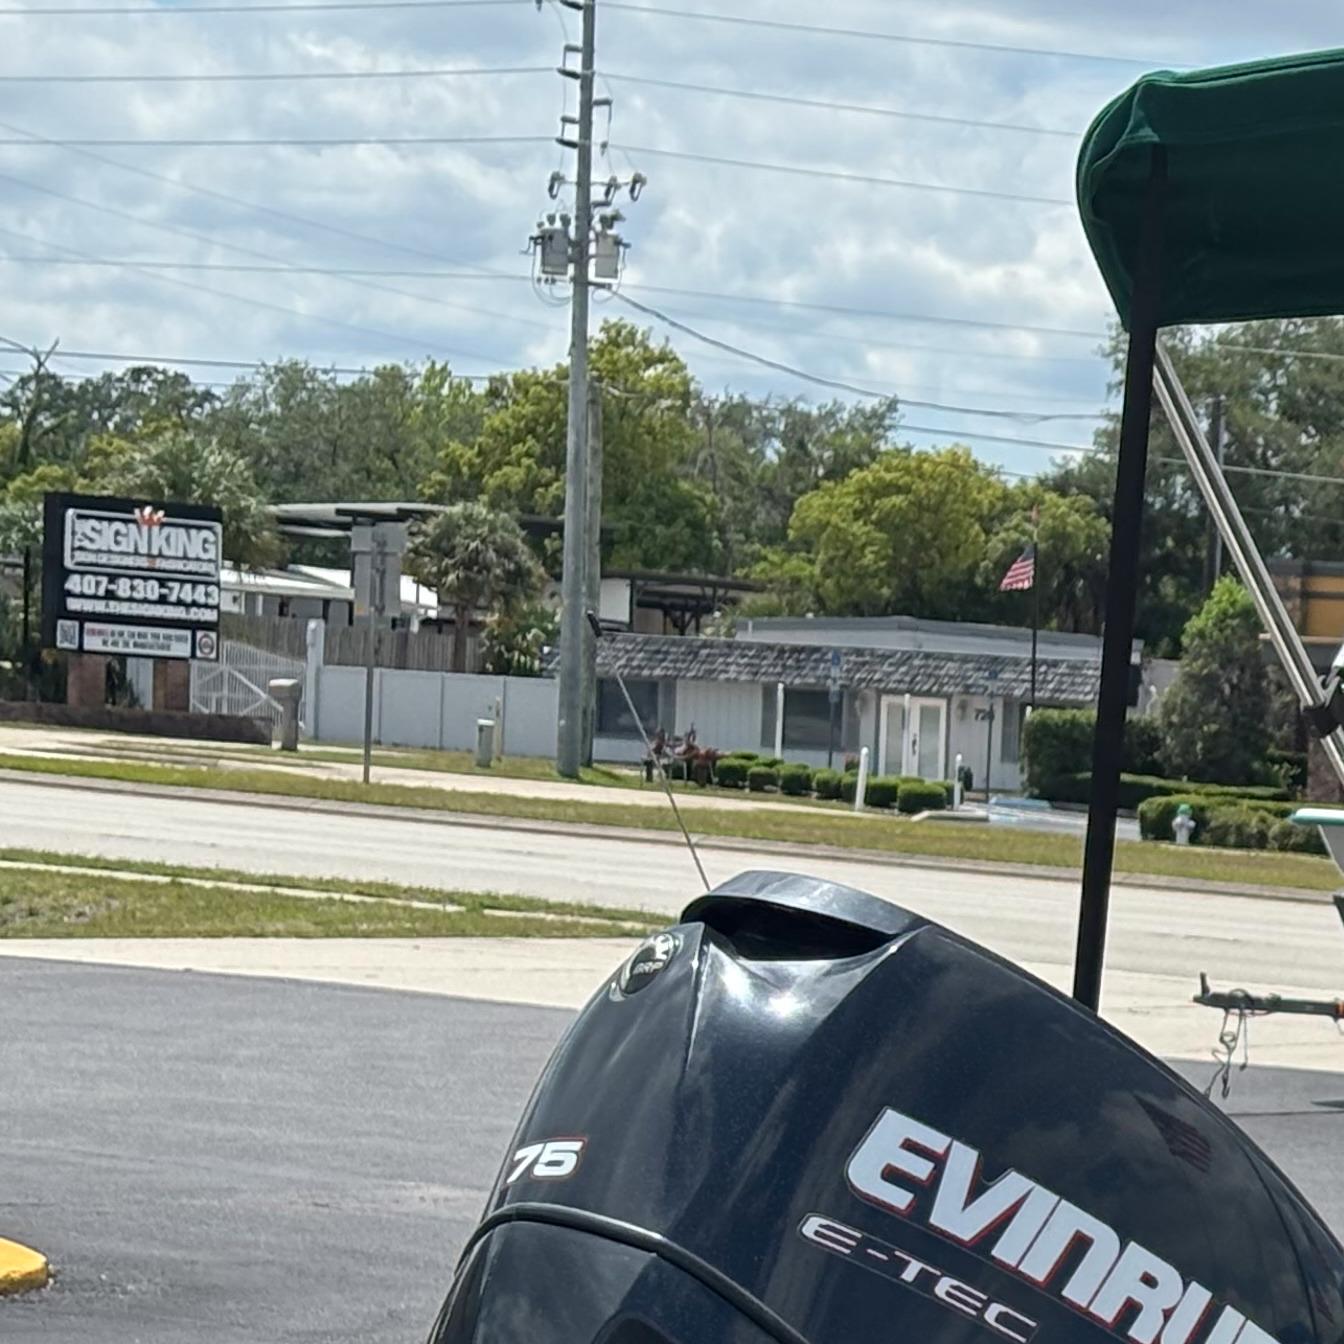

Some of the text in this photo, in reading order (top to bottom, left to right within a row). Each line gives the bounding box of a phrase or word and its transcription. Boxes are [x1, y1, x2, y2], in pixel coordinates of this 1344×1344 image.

[83, 518, 148, 554] SIGN
[151, 523, 217, 561] KING
[64, 574, 219, 606] 407-830-7443
[506, 1140, 584, 1184] 75
[801, 1216, 1037, 1334] E-TEC
